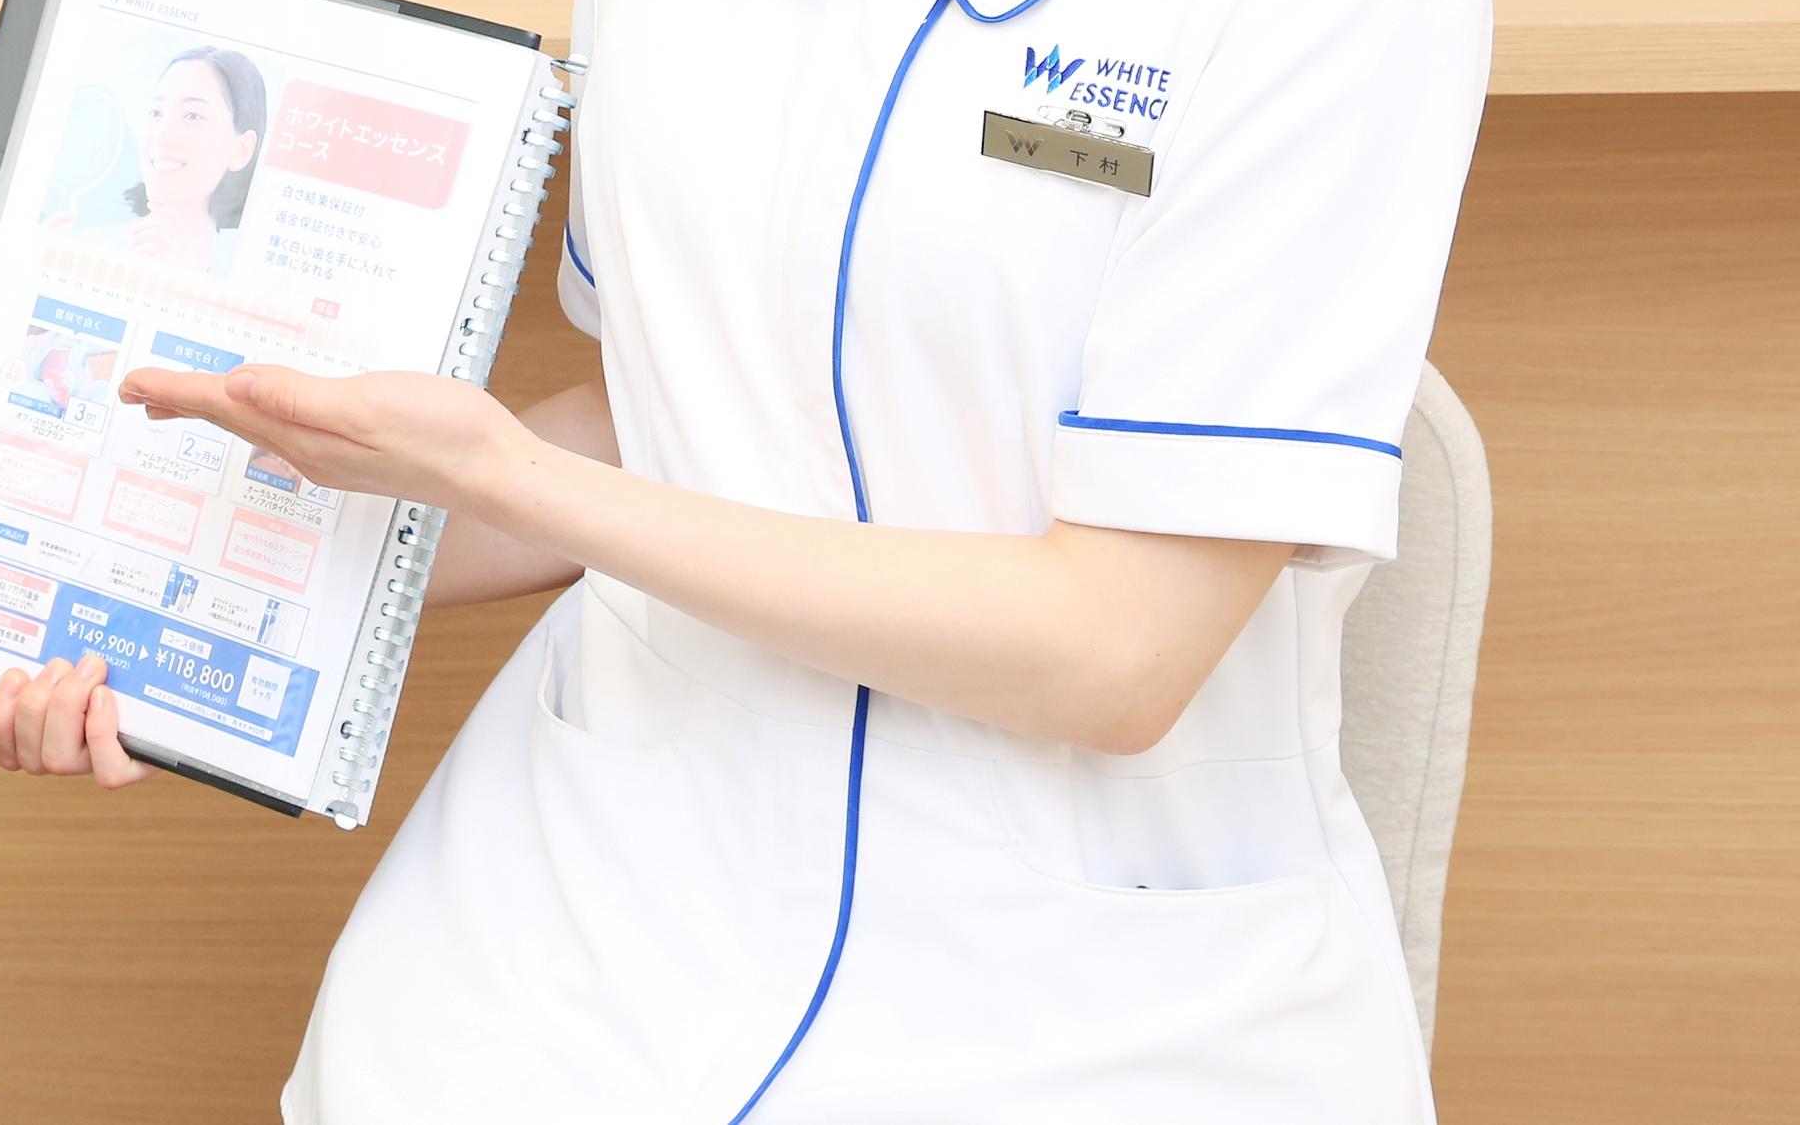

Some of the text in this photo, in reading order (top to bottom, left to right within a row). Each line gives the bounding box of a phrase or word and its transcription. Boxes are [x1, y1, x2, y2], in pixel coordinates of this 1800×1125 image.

[158, 4, 199, 21] ESSENCE
[1097, 58, 1172, 92] WHITE
[279, 132, 329, 159] コース
[286, 106, 446, 163] ホワイトエッセンス
[1069, 149, 1121, 176] 下村
[283, 185, 363, 217] 白さ結果保証付
[276, 209, 381, 249] 返金保証付きで安心
[265, 251, 333, 280] 笑顔になれる
[269, 234, 396, 279] 輝く白い歯を手に入れて
[55, 308, 100, 330] 医院で白く
[175, 345, 219, 366] 自宅で白く
[75, 403, 96, 424] 3回
[135, 449, 198, 475] ホームホワイトニング
[141, 460, 189, 481] スターターキット
[248, 485, 321, 515] オーラルスパクリーニング
[67, 621, 134, 656] ¥149,900
[167, 634, 203, 653] コース価格
[155, 649, 233, 693] ¥118,800
